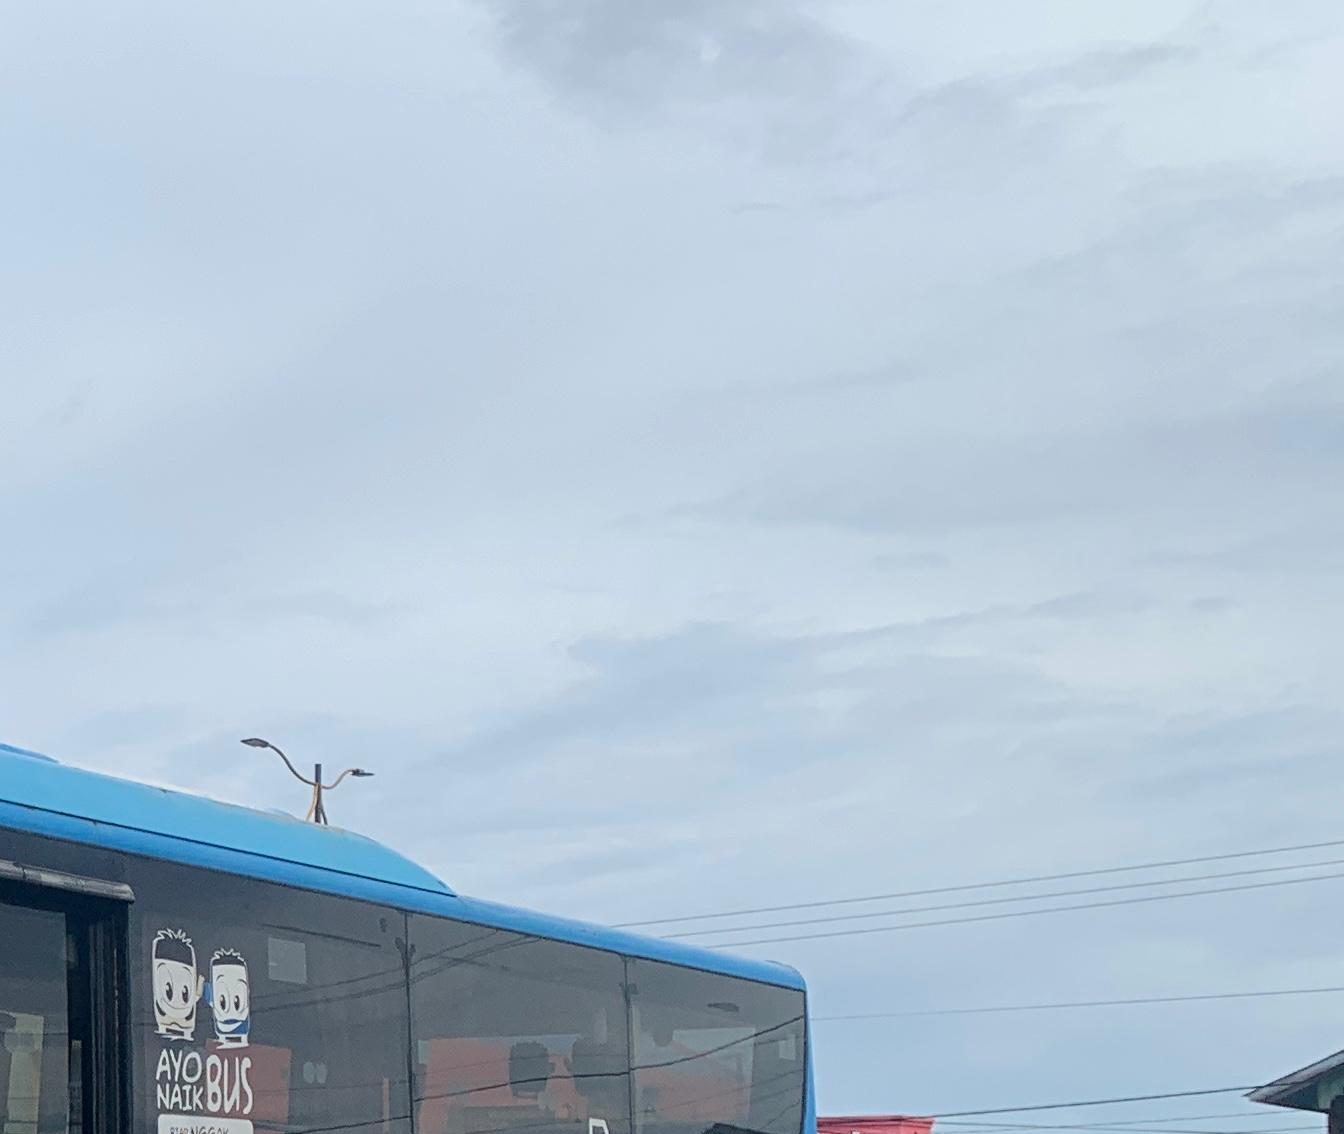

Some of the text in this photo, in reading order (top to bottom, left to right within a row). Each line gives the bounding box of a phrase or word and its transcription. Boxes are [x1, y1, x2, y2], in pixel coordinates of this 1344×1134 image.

[155, 1048, 202, 1083] AYO
[156, 1054, 253, 1115] NAIK BUS
